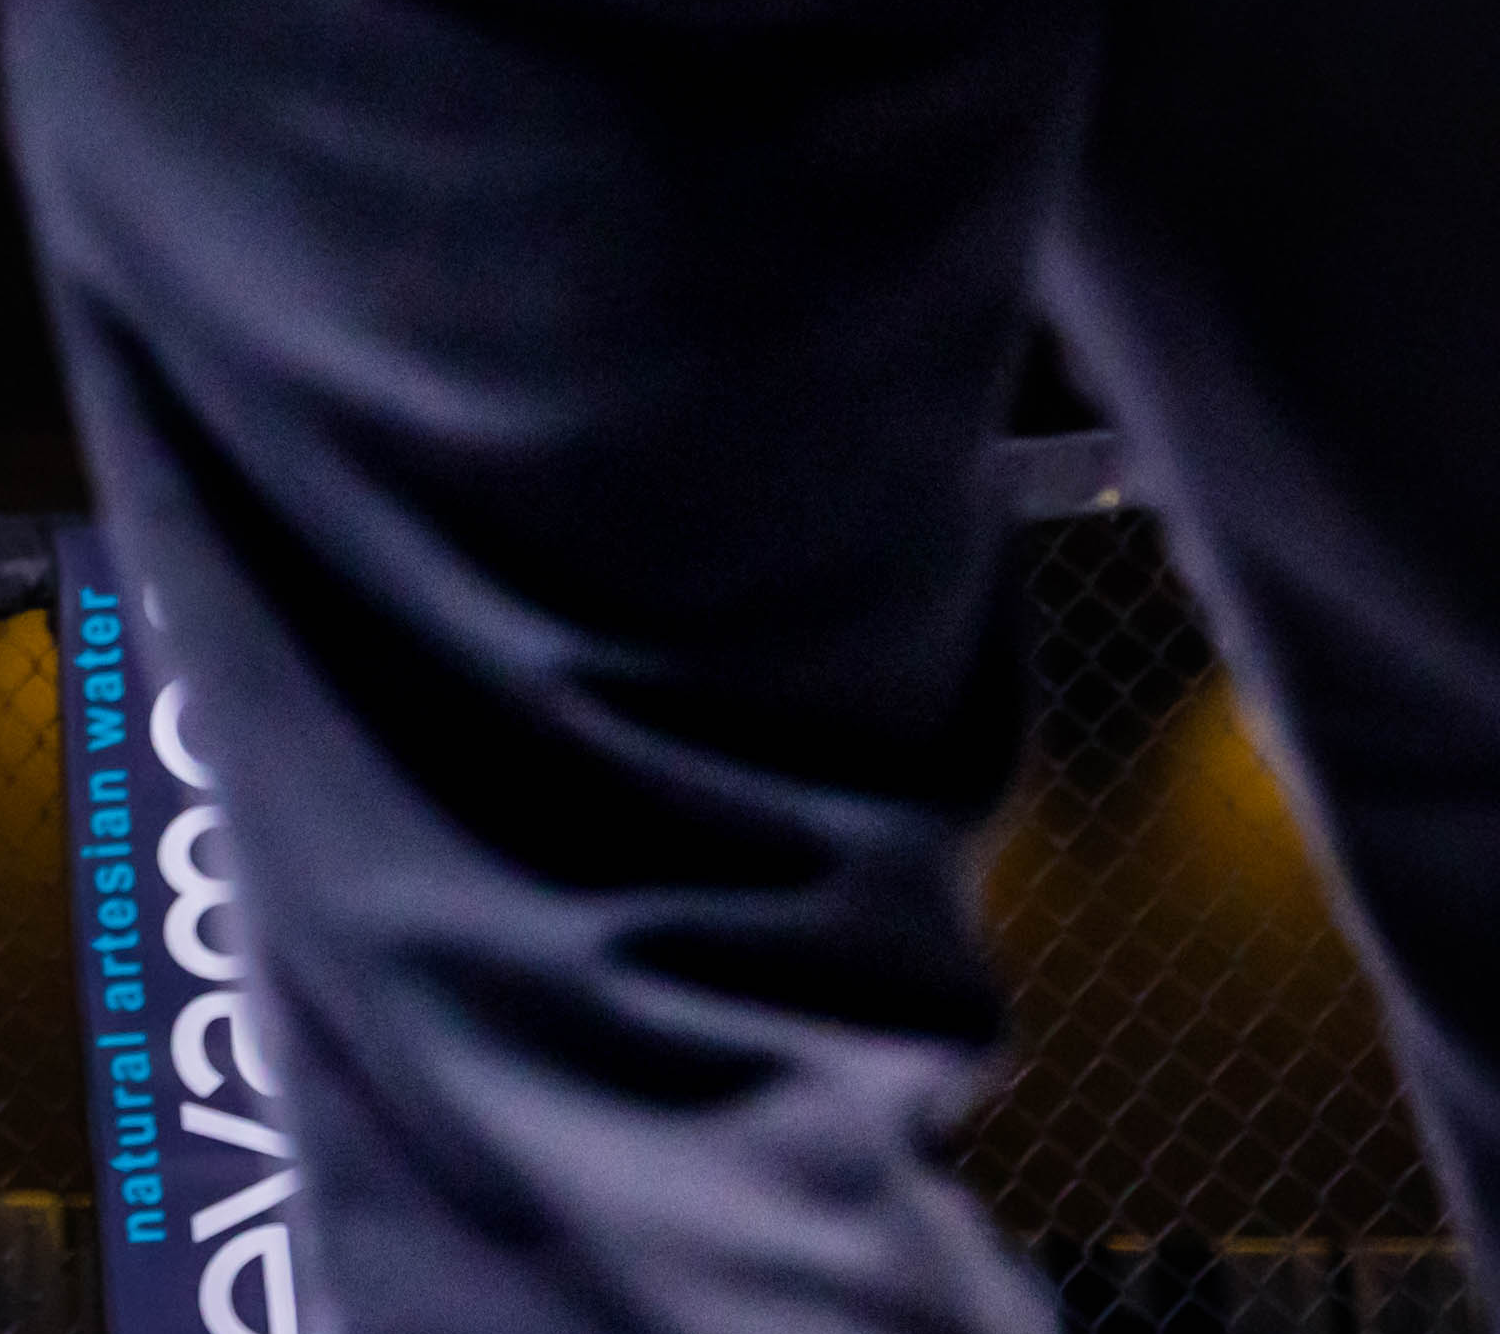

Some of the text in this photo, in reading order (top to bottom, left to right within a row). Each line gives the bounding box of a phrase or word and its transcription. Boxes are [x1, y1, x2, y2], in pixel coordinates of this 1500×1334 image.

[74, 585, 167, 1245] natural artesian water
